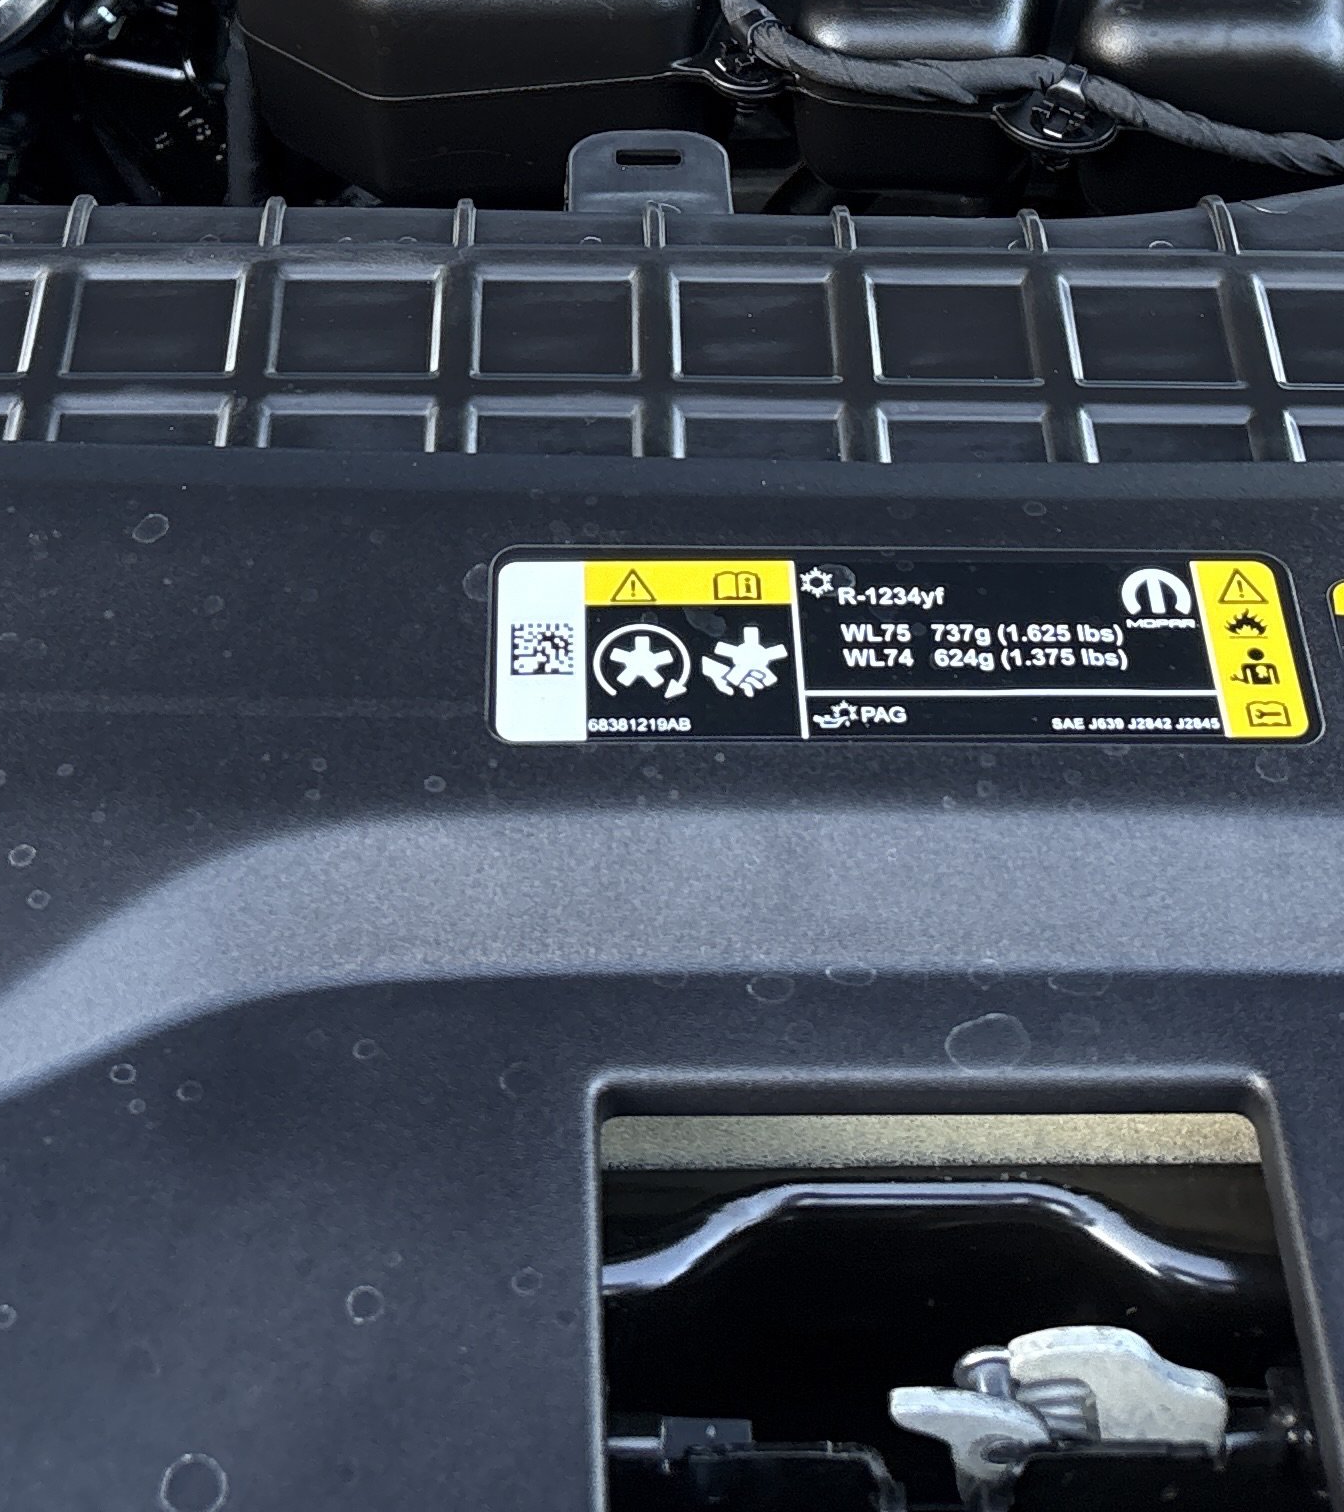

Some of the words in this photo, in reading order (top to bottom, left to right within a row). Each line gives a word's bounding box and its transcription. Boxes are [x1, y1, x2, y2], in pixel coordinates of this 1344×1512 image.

[838, 587, 944, 609] R-1234yf
[1126, 618, 1196, 629] MOPAR
[841, 624, 911, 642] WL75
[931, 624, 990, 646] 737g
[997, 624, 1071, 645] (1.625
[1078, 624, 1124, 646] lbs)
[843, 649, 914, 668] WL74
[933, 649, 995, 671] 624g
[1001, 648, 1076, 671] (1.375
[1082, 648, 1128, 671] lbs)
[860, 706, 908, 724] PAG
[1051, 717, 1085, 730] SAE
[1088, 717, 1125, 730] J639
[588, 717, 692, 732] 68381219AB
